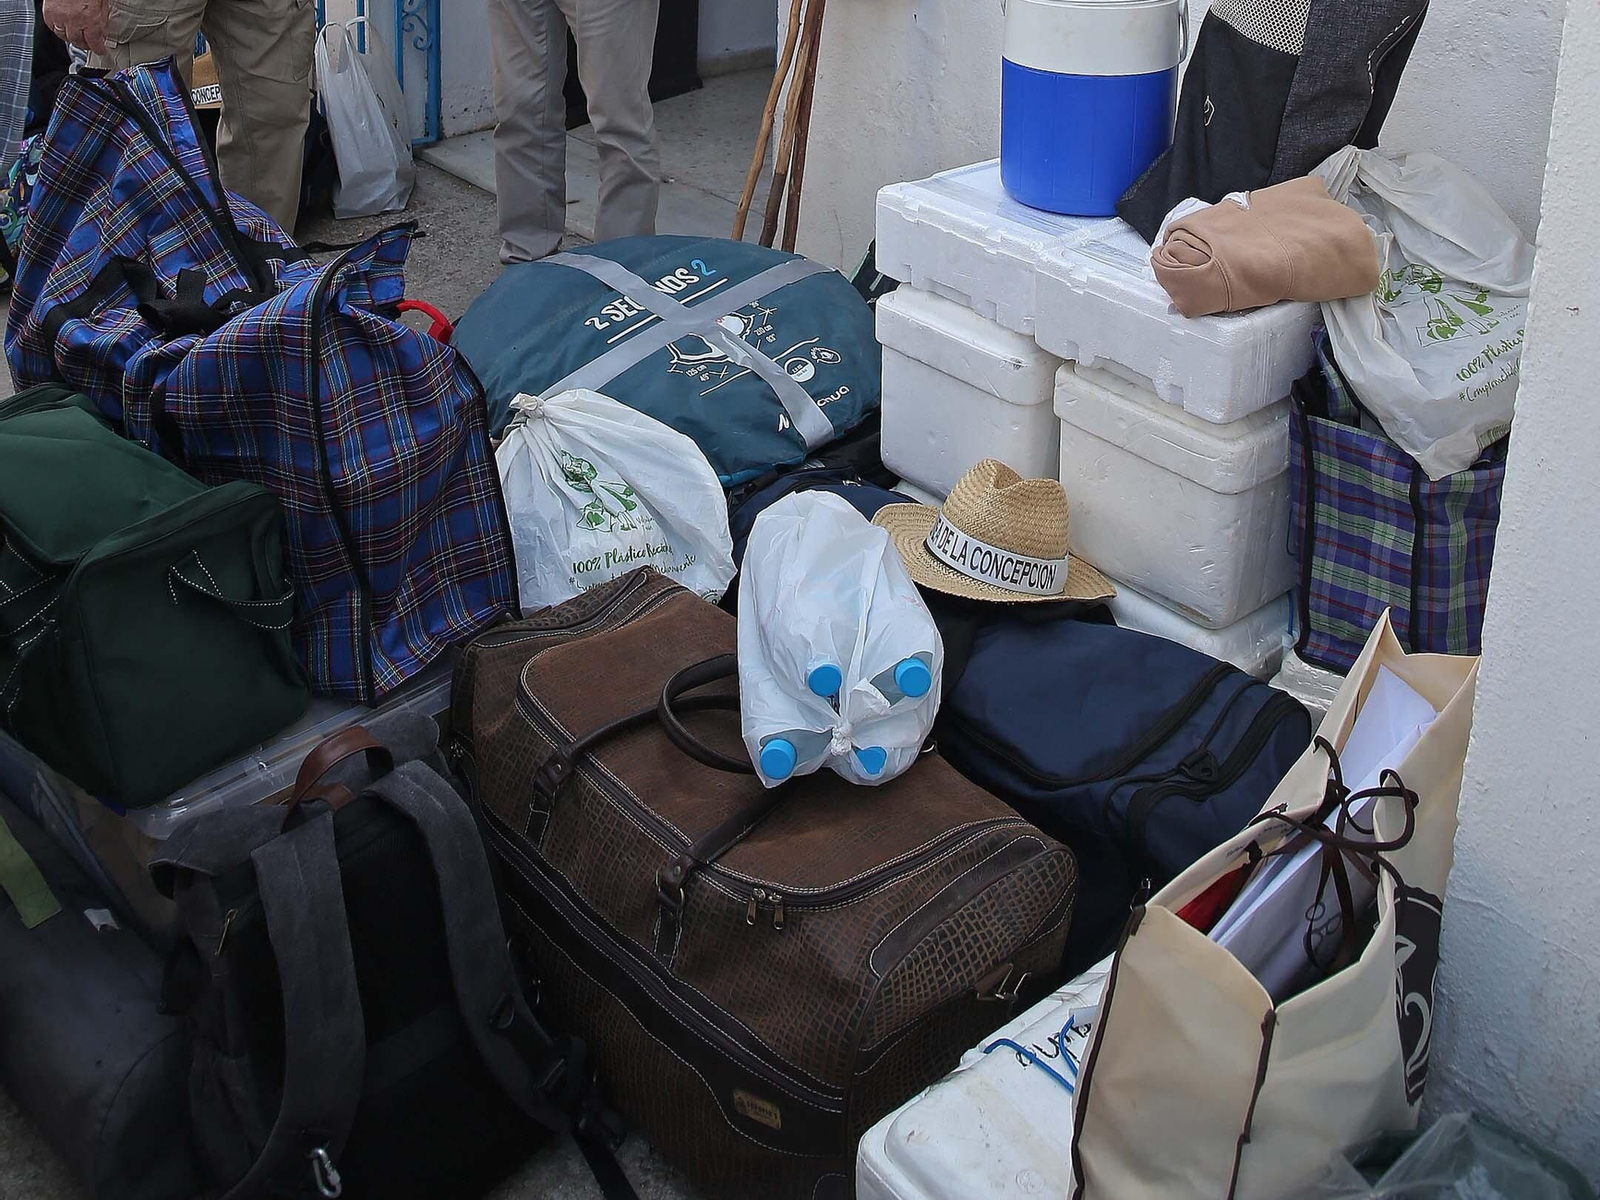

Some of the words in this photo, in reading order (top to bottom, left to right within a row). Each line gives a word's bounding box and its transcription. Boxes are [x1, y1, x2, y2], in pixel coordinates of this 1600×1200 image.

[584, 317, 611, 330] 2
[691, 259, 717, 277] 2
[1456, 356, 1485, 382] 100%
[572, 556, 602, 575] 100%
[938, 526, 955, 555] DE
[950, 533, 970, 566] LA
[969, 546, 1058, 590] CONCEPCION
